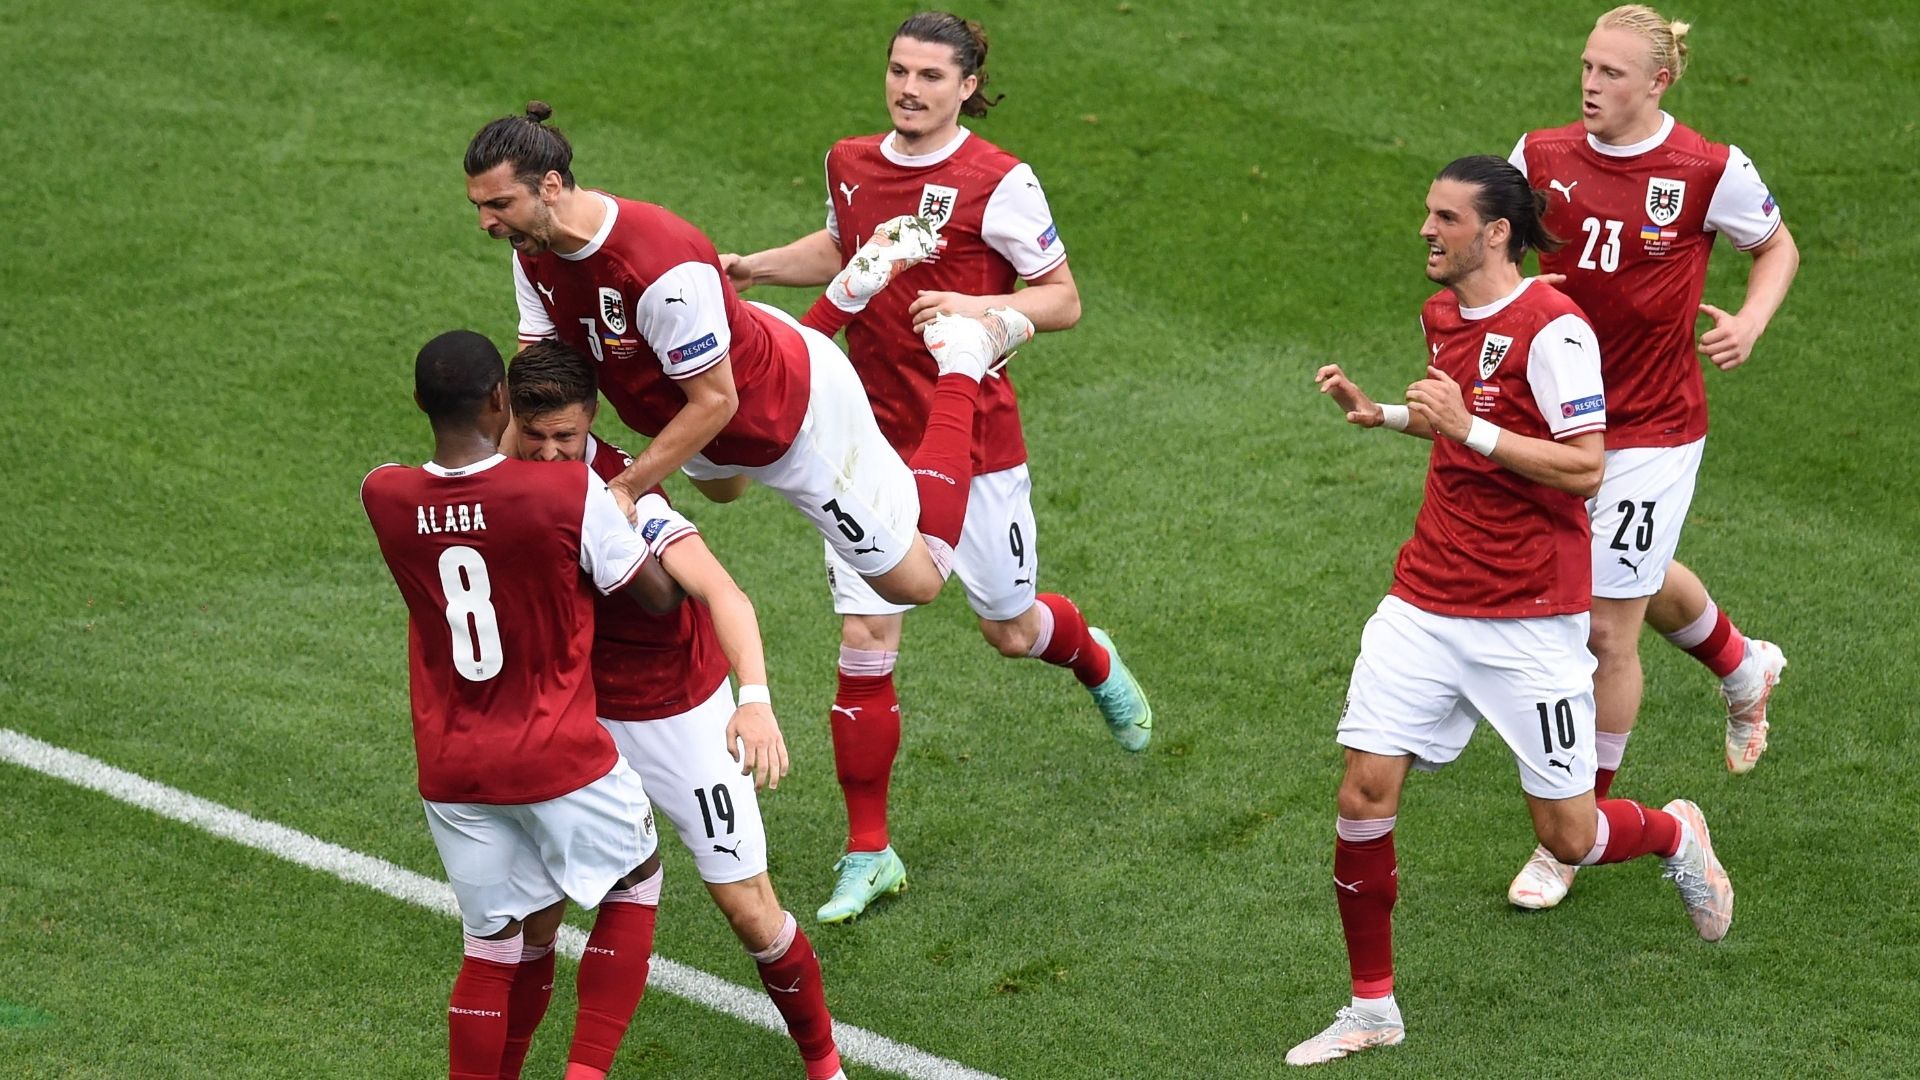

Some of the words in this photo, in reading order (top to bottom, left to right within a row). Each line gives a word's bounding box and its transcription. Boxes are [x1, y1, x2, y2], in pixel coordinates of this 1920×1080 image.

[1577, 216, 1624, 273] 23
[682, 336, 716, 357] RESPECT
[1575, 399, 1603, 412] RESPECT
[417, 503, 487, 535] ALABA
[821, 498, 865, 543] 3
[1610, 500, 1656, 552] 23
[1009, 522, 1024, 569] 9
[438, 545, 504, 682] 8
[1536, 698, 1576, 754] 10
[694, 783, 735, 839] 19
